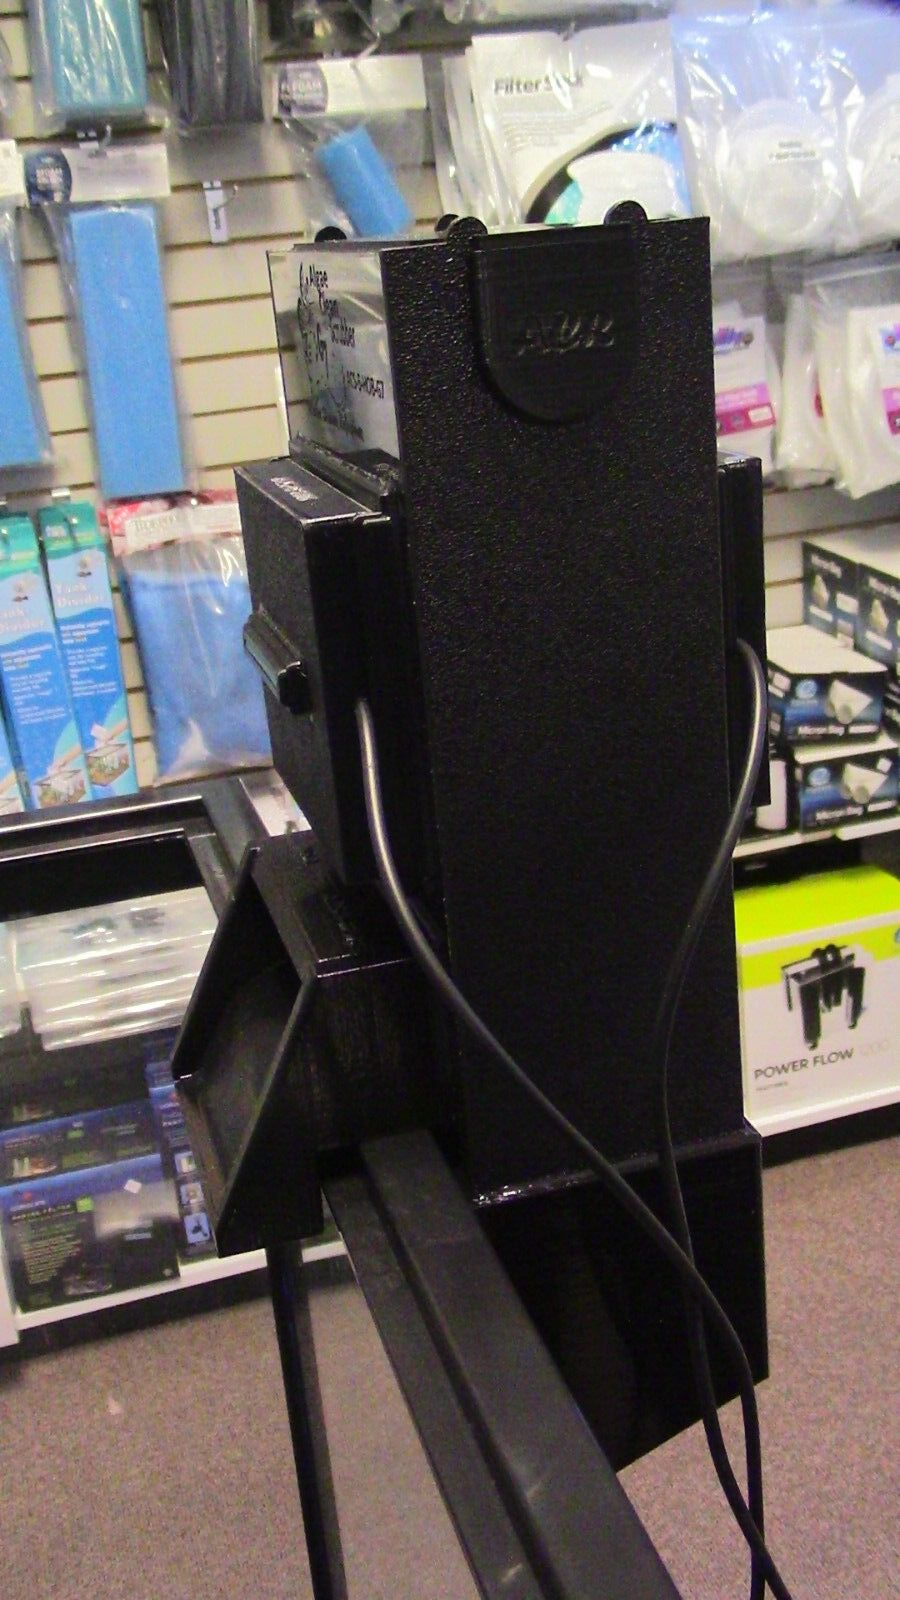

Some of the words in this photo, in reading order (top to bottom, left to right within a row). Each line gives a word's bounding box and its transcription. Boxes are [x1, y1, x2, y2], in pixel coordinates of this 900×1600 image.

[494, 77, 541, 94] Filter
[754, 1058, 808, 1080] POWER
[813, 1048, 854, 1068] FLOW
